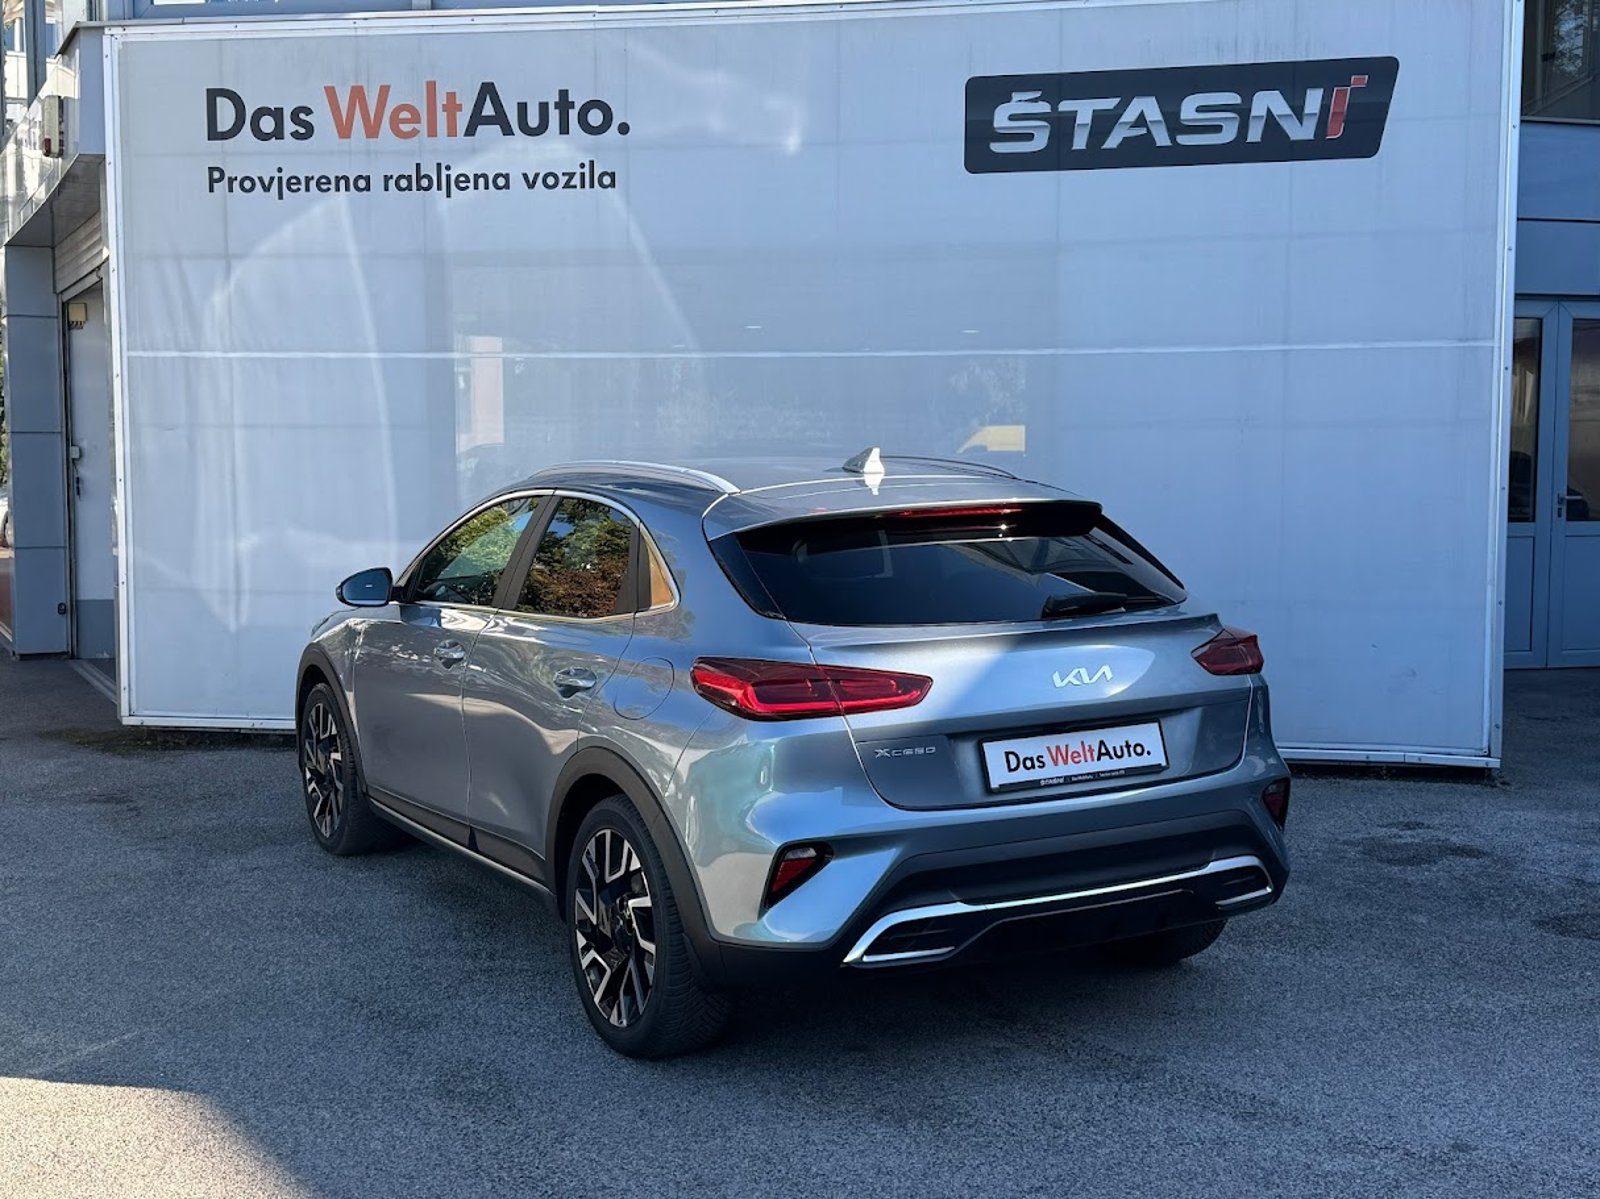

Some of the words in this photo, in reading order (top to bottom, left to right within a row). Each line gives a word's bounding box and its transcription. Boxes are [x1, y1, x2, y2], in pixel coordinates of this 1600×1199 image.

[205, 87, 315, 141] Das
[324, 80, 631, 140] WeltAuto.
[207, 166, 372, 200] Provjerena
[383, 163, 511, 198] rabljena
[522, 160, 617, 190] vozila
[1052, 664, 1113, 689] KIA
[1004, 749, 1046, 773] Das
[1046, 740, 1152, 767] WeltAuto.
